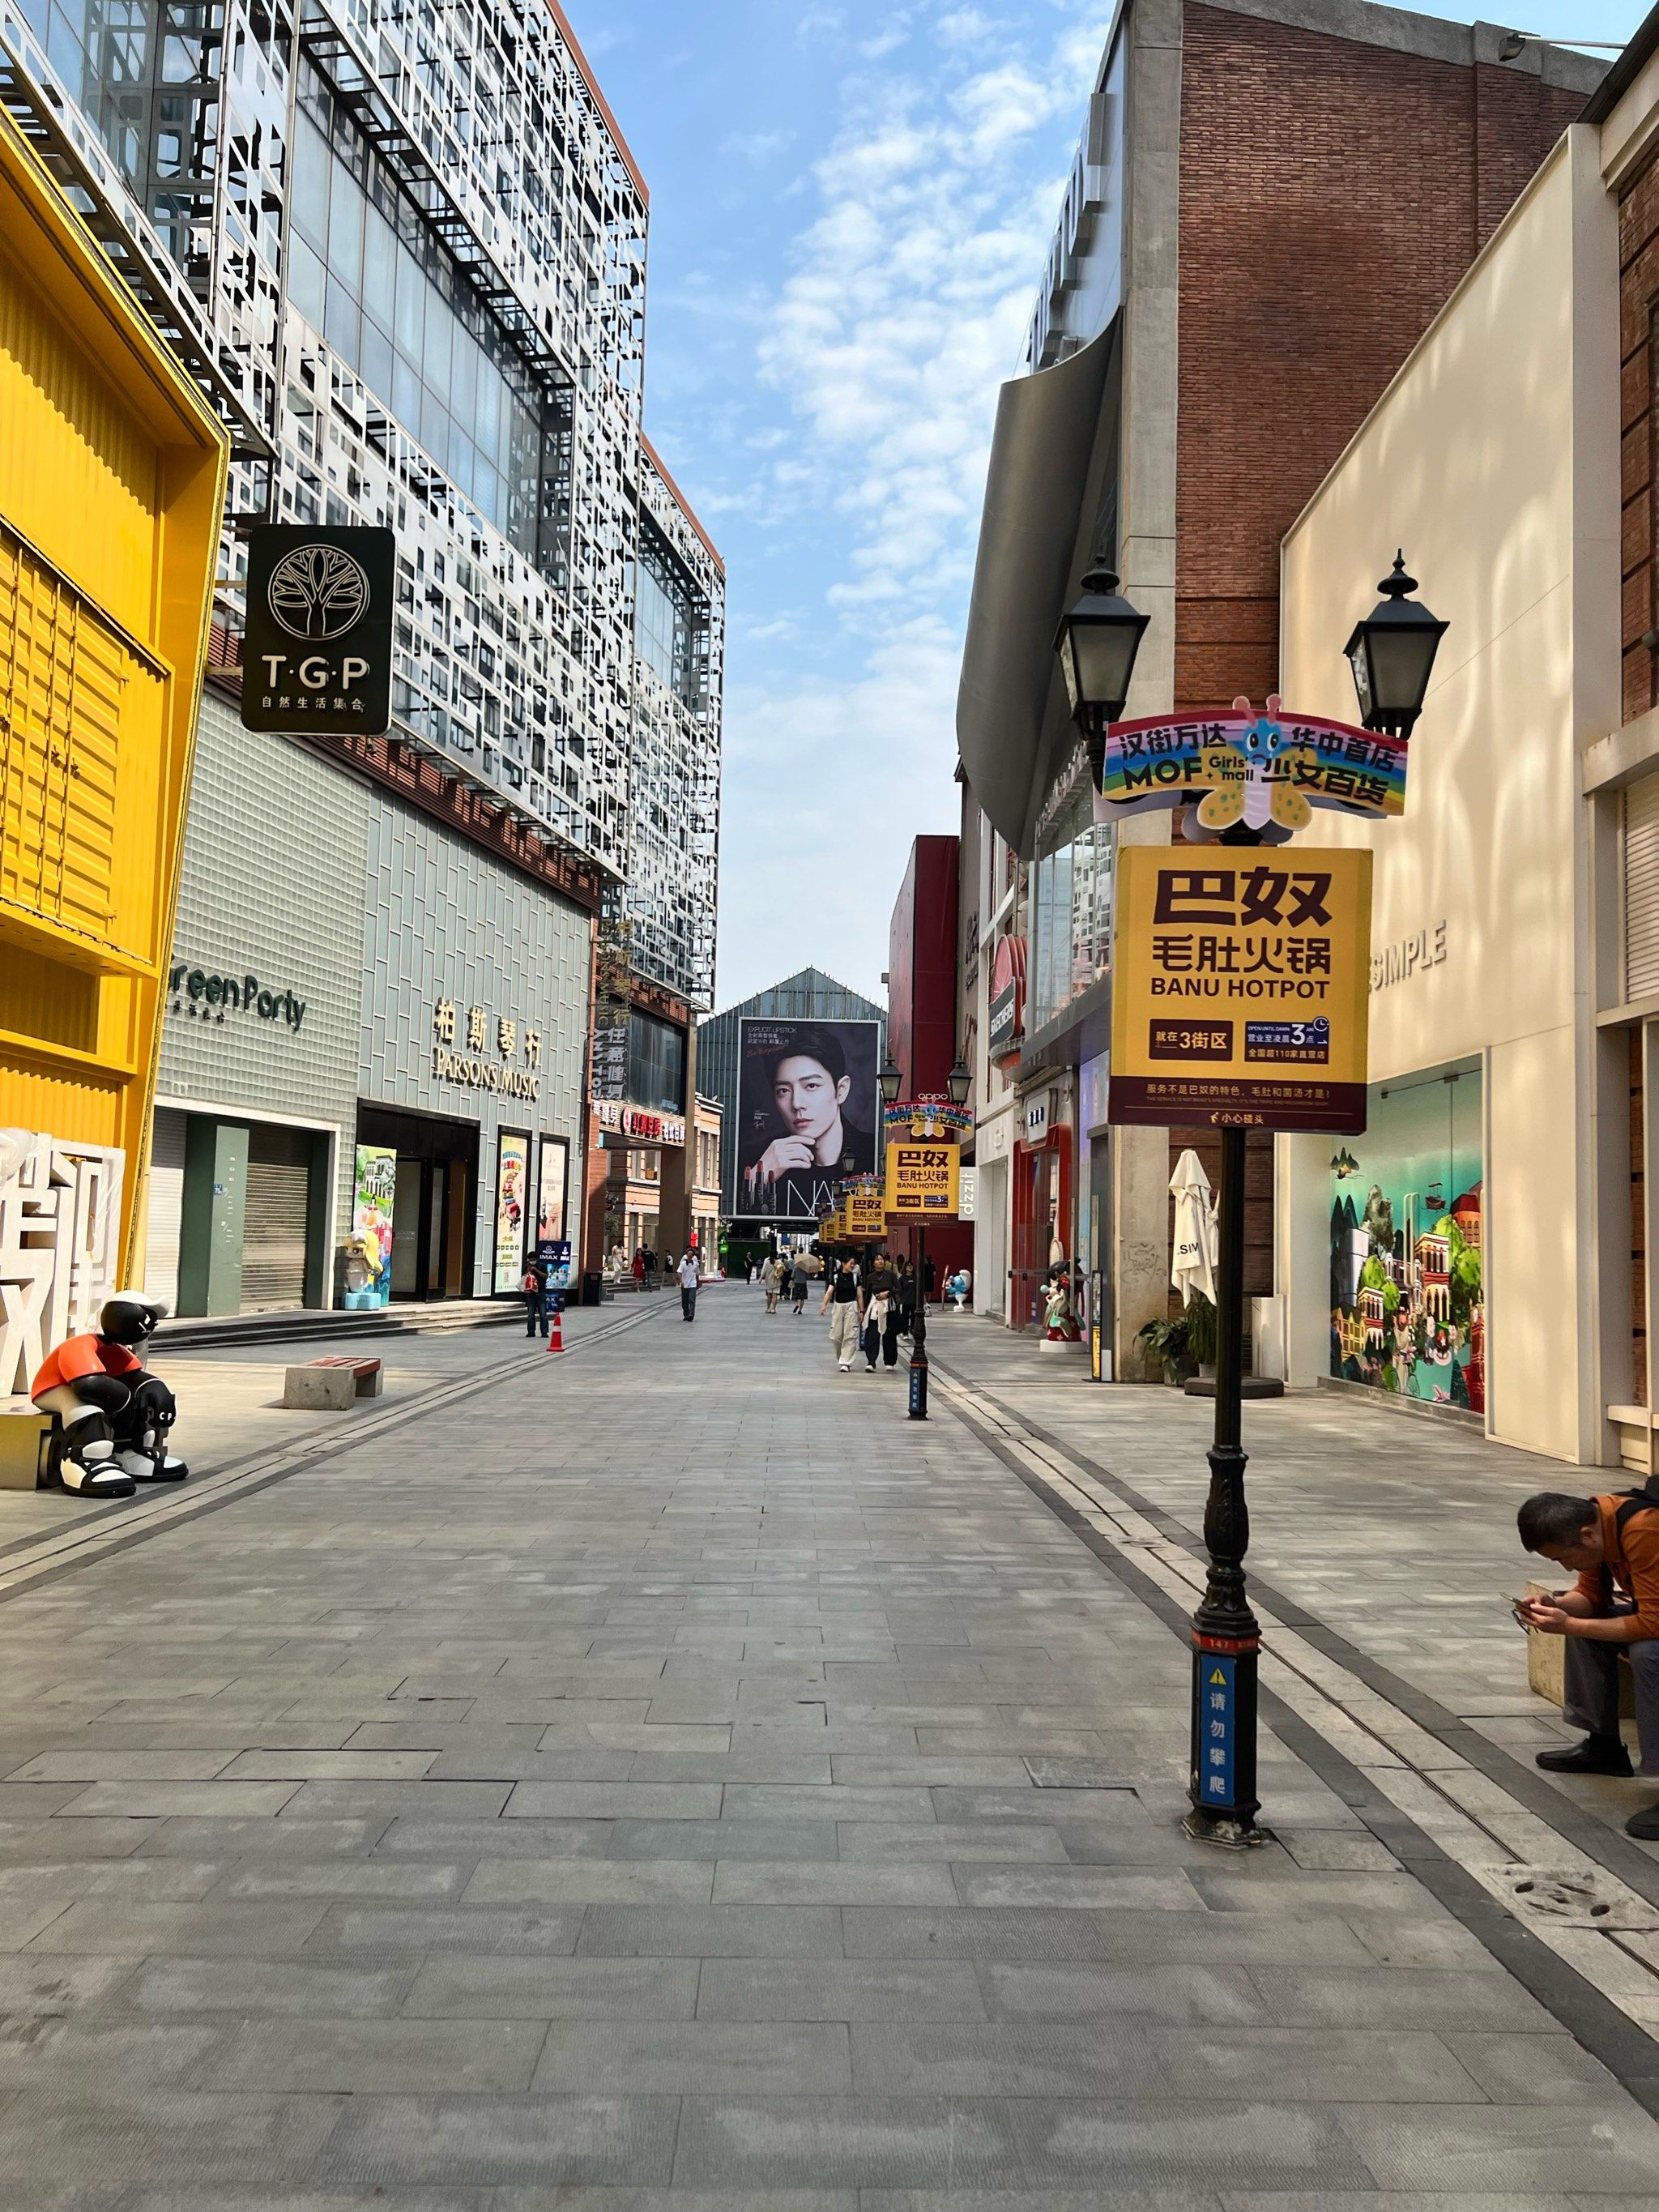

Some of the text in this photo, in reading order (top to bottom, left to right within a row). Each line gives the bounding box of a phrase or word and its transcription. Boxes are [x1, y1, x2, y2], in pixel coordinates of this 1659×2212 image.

[262, 695, 365, 713] 自然生活集合
[1119, 723, 1226, 761] 汉街万达
[1290, 727, 1399, 773] 华中首店
[1123, 756, 1202, 791] MOF
[1222, 770, 1254, 782] mall
[1260, 758, 1388, 805] 少女百货
[1153, 866, 1333, 928] 巴奴
[1153, 933, 1331, 975] 毛肚火锅
[168, 954, 240, 1008] reen
[245, 975, 306, 1032] Party
[1151, 977, 1330, 999] BANU HOTPOT
[434, 997, 541, 1068] 柏斯琴行
[1155, 1031, 1227, 1049] 就在3街区
[433, 1047, 541, 1100] PARSONS MUSIC
[890, 1115, 913, 1124] MOF
[897, 1170, 949, 1182] 毛肚火锅
[898, 1150, 949, 1168] 巴奴
[853, 1199, 881, 1209] 巴奴
[1209, 1638, 1229, 1648] 147
[1209, 1693, 1226, 1795] 请勿攀爬
